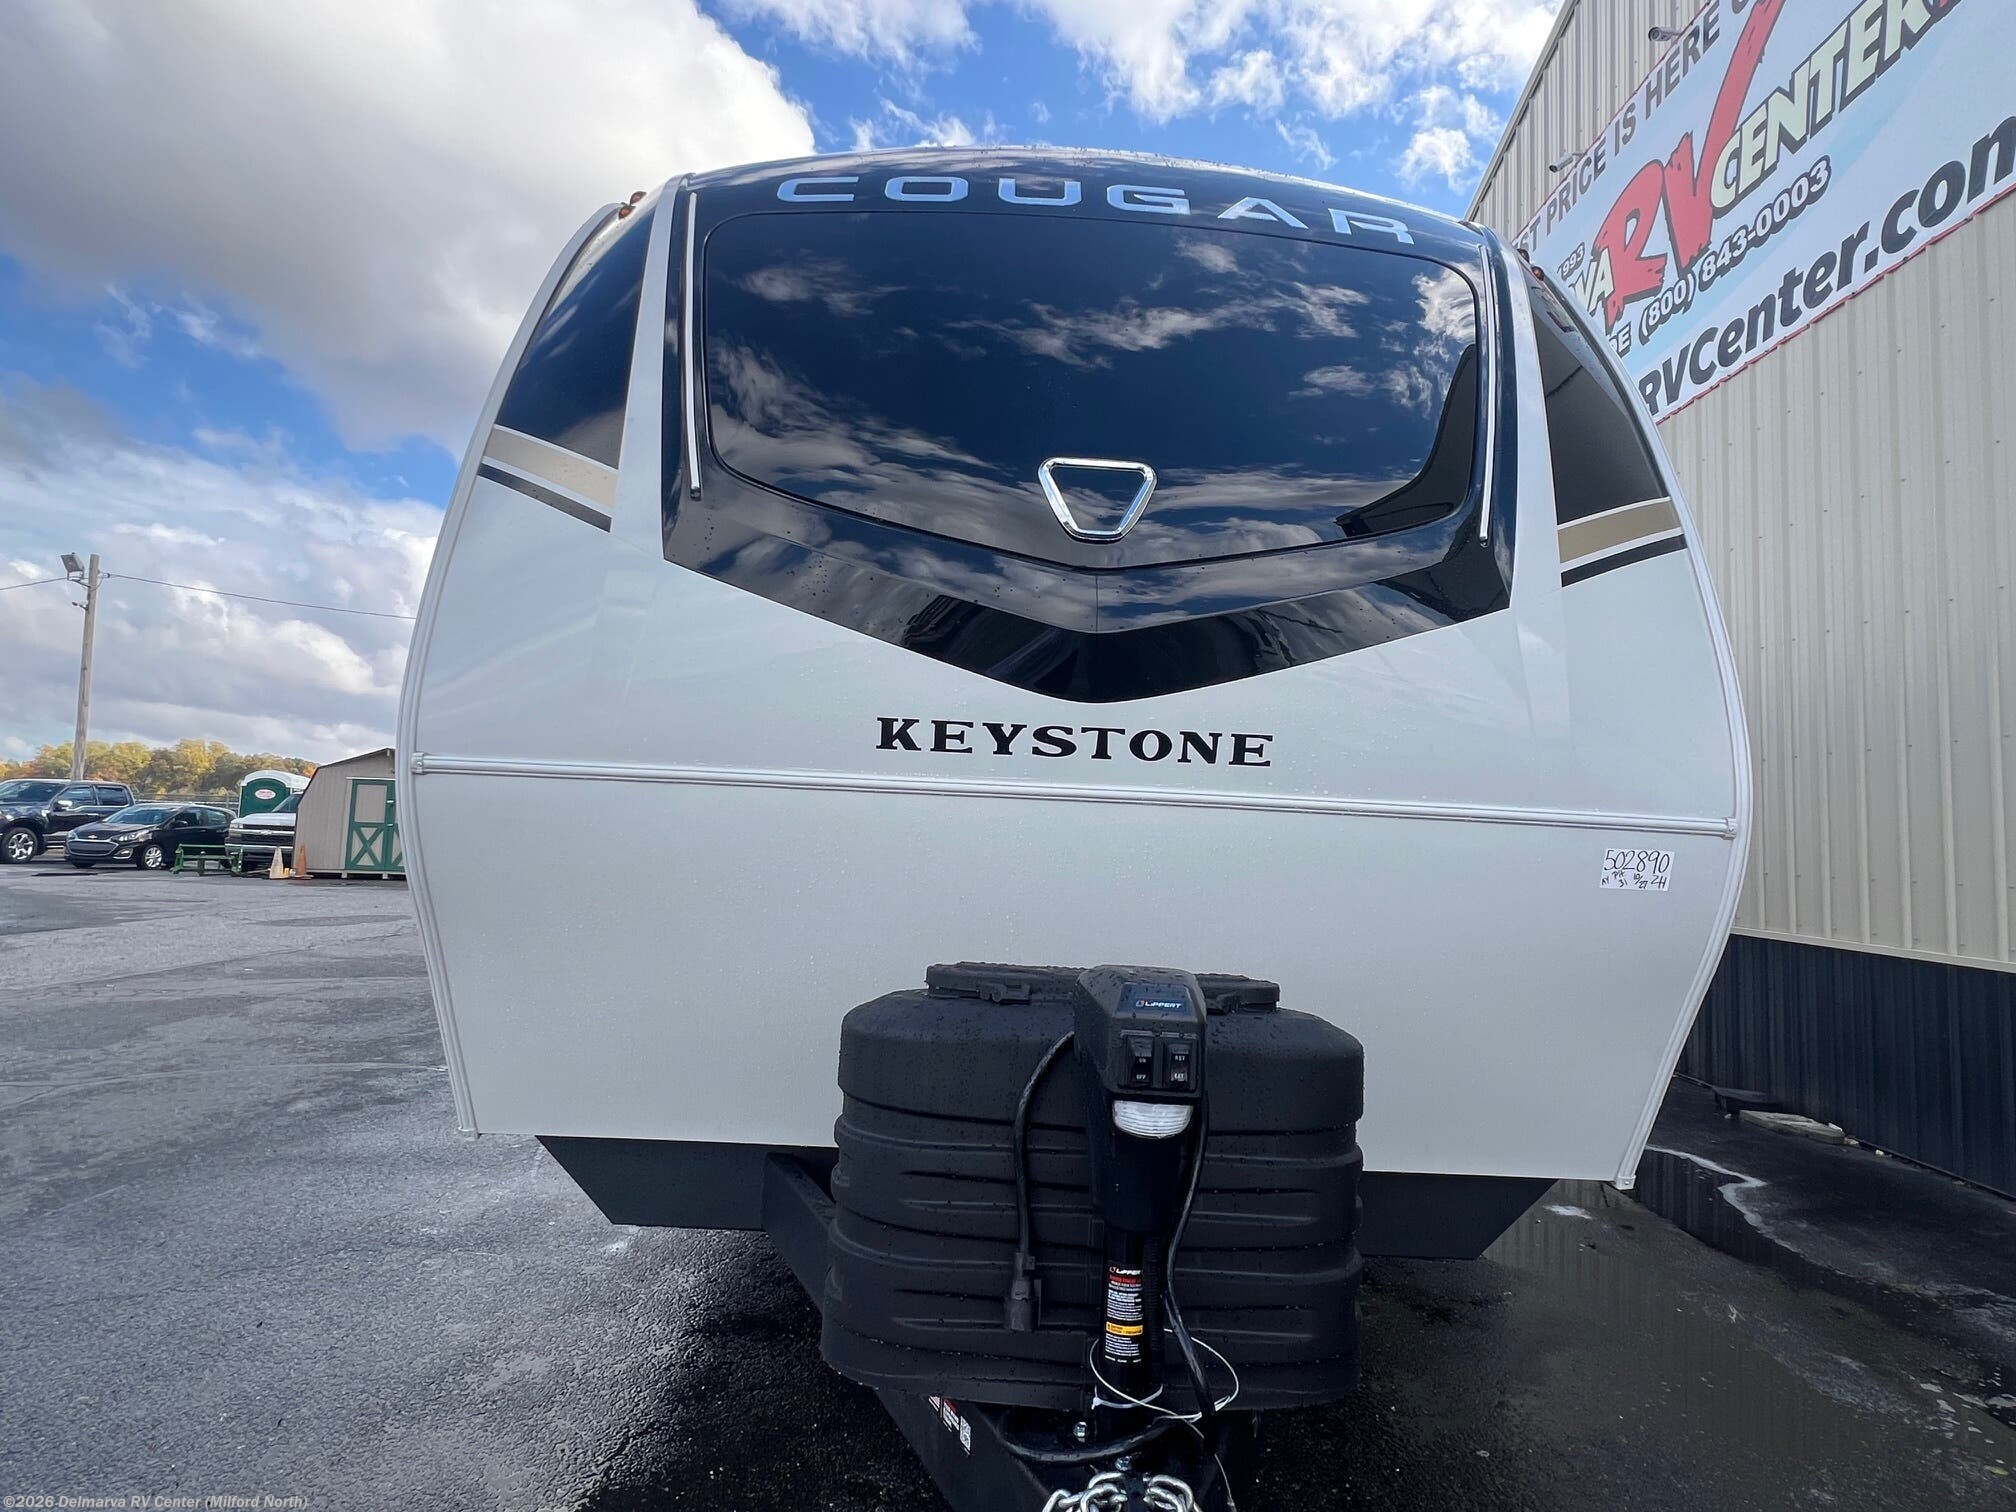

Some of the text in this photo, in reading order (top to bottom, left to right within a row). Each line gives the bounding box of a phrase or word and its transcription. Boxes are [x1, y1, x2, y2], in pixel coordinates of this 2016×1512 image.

[1546, 135, 1607, 237] PRICE
[1614, 101, 1637, 158] IS
[1645, 0, 1720, 121] HERE
[776, 175, 1416, 246] COUGAR
[1639, 269, 1697, 346] (800)
[1698, 154, 1832, 292] 843-0003
[875, 716, 1274, 768] KEYSTONE
[1604, 850, 1670, 874] 502890
